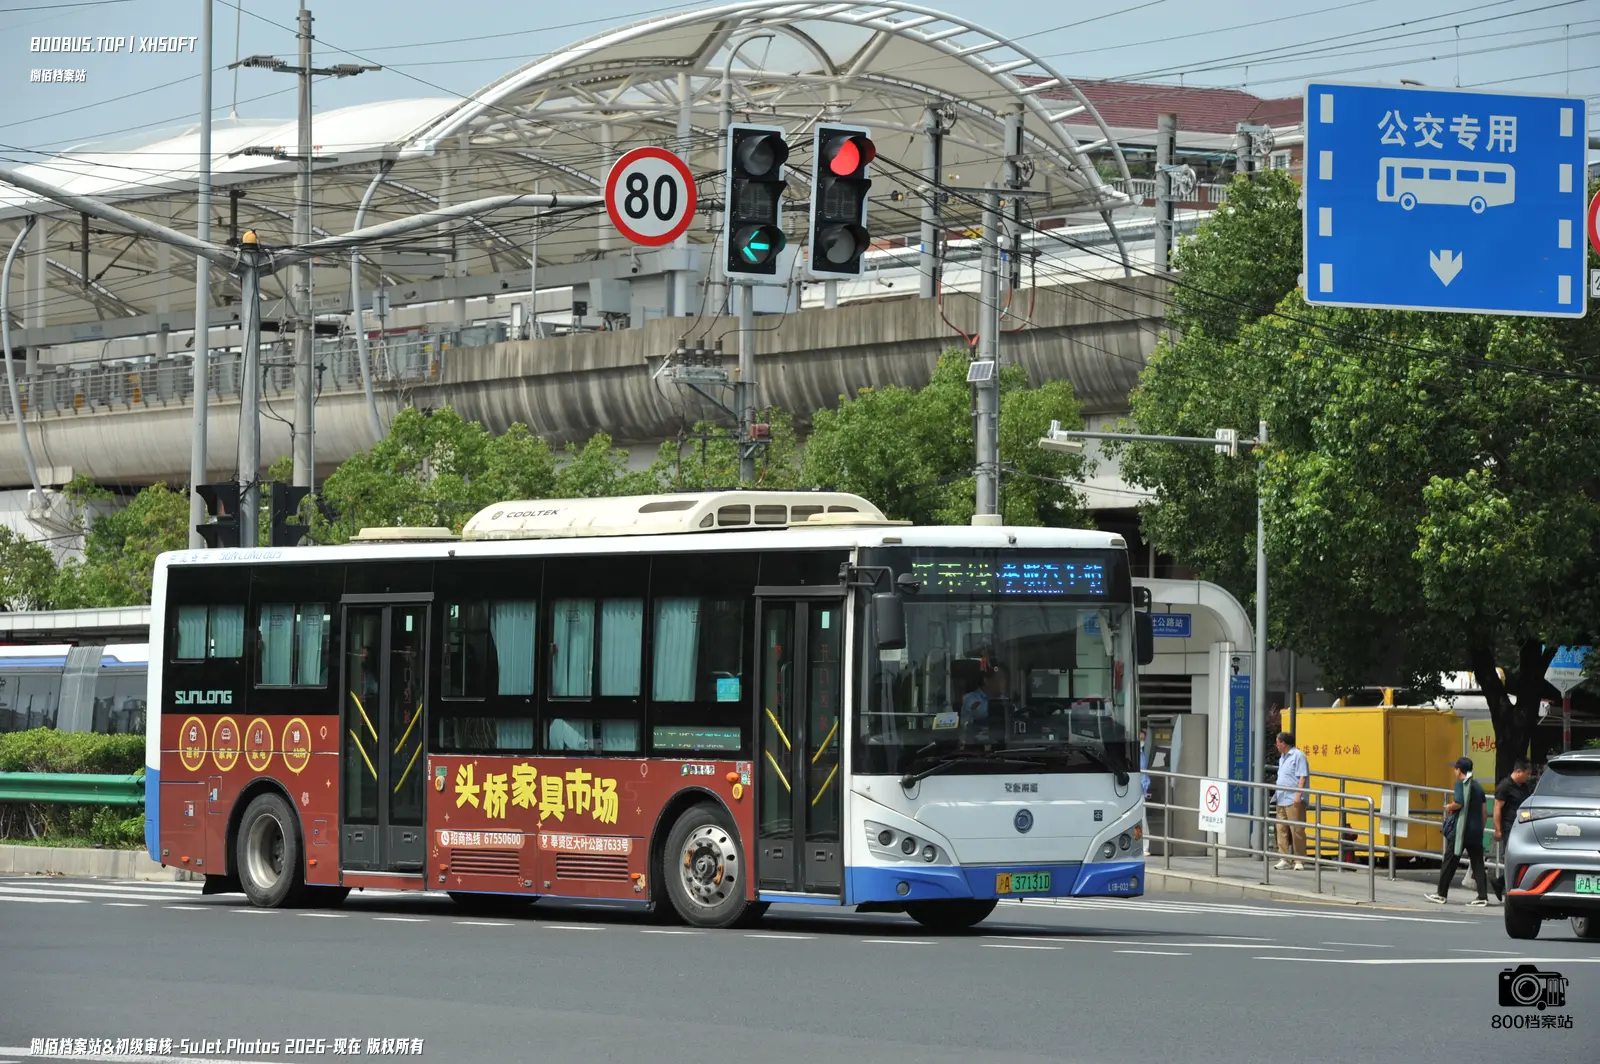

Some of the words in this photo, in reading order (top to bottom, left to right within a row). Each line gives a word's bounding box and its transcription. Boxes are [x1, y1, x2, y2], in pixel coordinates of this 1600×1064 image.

[1377, 110, 1518, 153] 公交专用
[624, 172, 678, 221] 80
[506, 509, 560, 518] COOLTEK
[175, 690, 232, 704] SUNLONG
[1297, 744, 1328, 756] 海早餐
[455, 762, 619, 825] 头桥家具市场
[451, 832, 480, 845] 招商热线
[484, 833, 521, 845] 67550600
[551, 836, 629, 852] 奉贤区大叶公路7633号
